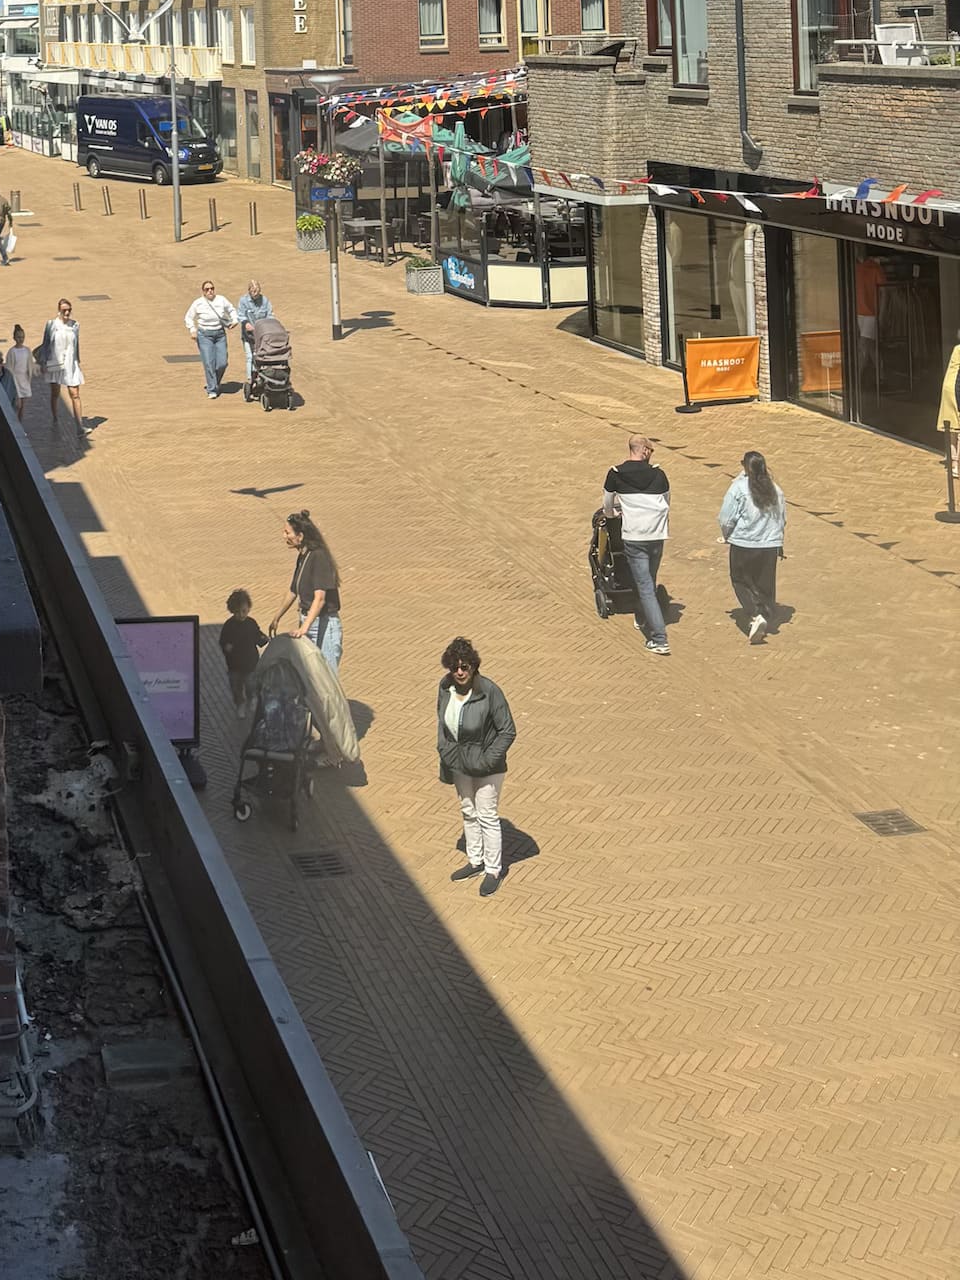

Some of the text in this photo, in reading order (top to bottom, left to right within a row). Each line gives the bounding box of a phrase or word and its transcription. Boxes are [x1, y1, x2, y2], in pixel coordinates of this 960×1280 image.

[95, 118, 108, 130] VAN
[866, 222, 904, 242] MODE
[700, 357, 745, 368] HAASNOOT
